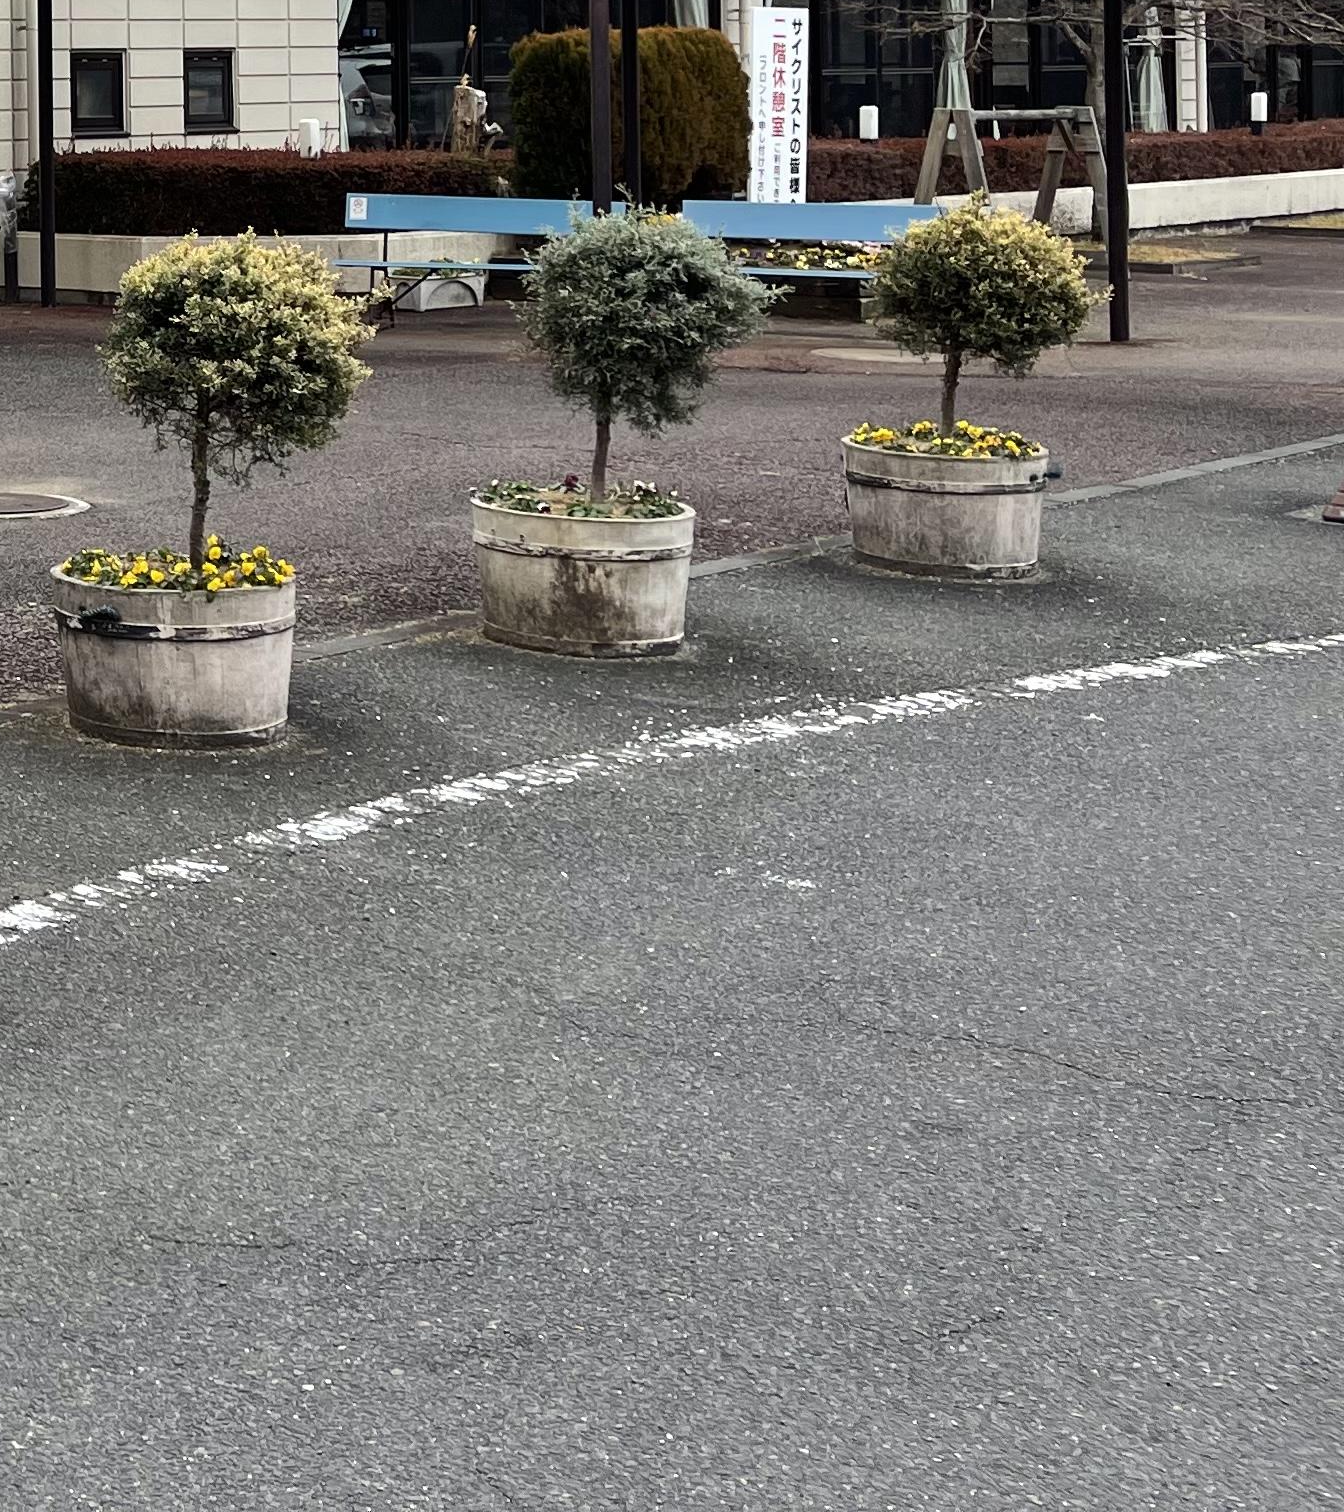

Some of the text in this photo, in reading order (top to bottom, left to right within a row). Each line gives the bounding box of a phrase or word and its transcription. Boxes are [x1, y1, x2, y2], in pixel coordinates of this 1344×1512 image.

[771, 18, 787, 137] 二階休憩室
